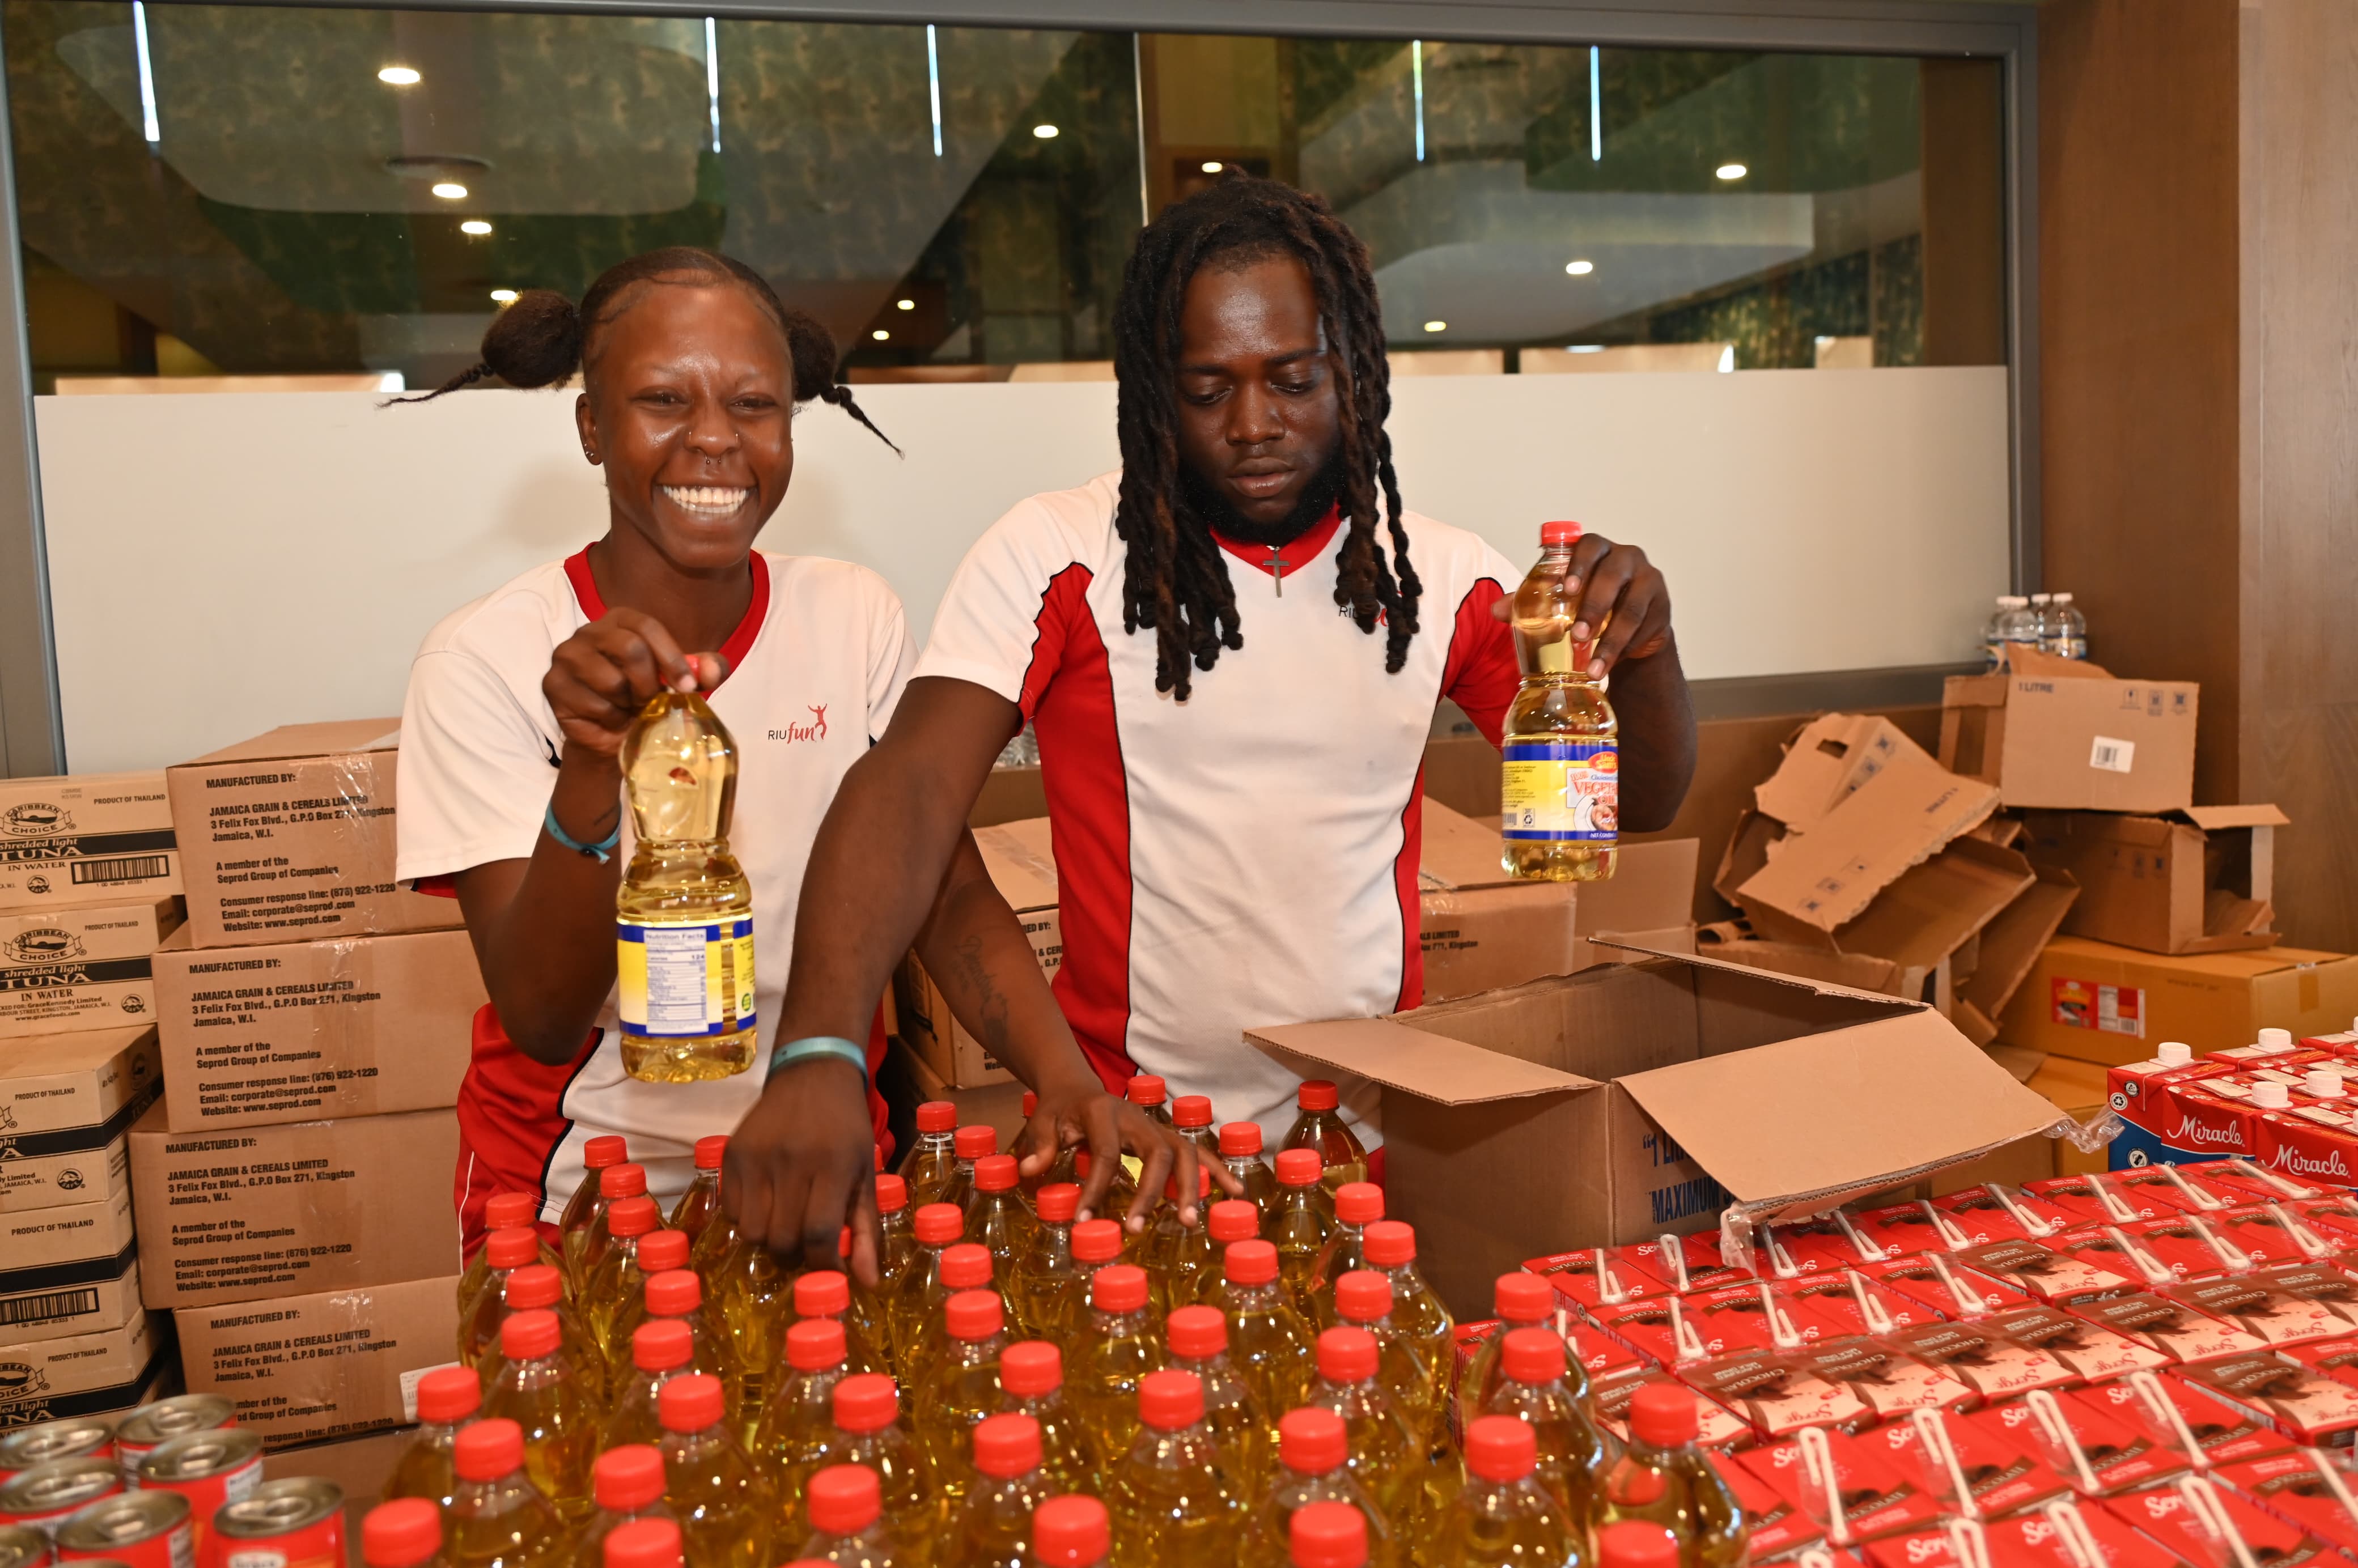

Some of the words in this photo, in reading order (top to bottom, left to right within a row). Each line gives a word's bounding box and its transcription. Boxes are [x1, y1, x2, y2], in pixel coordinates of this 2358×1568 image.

[2024, 682, 2054, 693] LITRE
[768, 730, 787, 740] RIU
[787, 721, 815, 744] fun
[206, 774, 279, 788] MANUFACTURED
[281, 773, 295, 783] BY:
[7, 804, 59, 817] CARIBBEAN
[210, 804, 251, 817] JAMAICA
[252, 802, 280, 813] GRAIN
[282, 801, 289, 811] &
[291, 798, 330, 810] CEREALS
[12, 824, 57, 834] CHOICE
[211, 820, 217, 830] 3
[219, 818, 241, 828] Felix
[243, 817, 260, 827] Fox
[261, 815, 288, 825] Blvd.,
[290, 811, 315, 823] G.P.O
[316, 811, 333, 821] Box
[0, 839, 49, 850] shredded
[52, 838, 78, 848] light
[213, 831, 253, 842] Jamaica,
[255, 828, 274, 838] W.I.
[0, 847, 84, 861] TUNA
[25, 861, 66, 870] WATER
[217, 861, 223, 871] A
[224, 859, 260, 870] member
[262, 857, 272, 867] of
[274, 856, 289, 866] the
[217, 872, 249, 885] Seprod
[250, 871, 277, 881] Group
[279, 869, 288, 878] of
[290, 865, 339, 878] Companies
[220, 896, 265, 907] Consumer
[266, 892, 307, 904] response
[308, 890, 329, 899] line:
[354, 882, 396, 895] 922-1220
[222, 908, 250, 920] Email:
[252, 900, 355, 917] corporate@seprod.com
[223, 920, 263, 932] Website:
[264, 914, 341, 928] www.seprod.com
[20, 950, 67, 961] CHOICE
[5, 965, 56, 978] shredded
[59, 964, 86, 974] light
[189, 959, 264, 974] MANUFACTURED
[266, 958, 281, 968] BY:
[1, 973, 93, 989] TUNA
[21, 993, 32, 1002] IN
[37, 988, 74, 1000] WATER
[192, 990, 234, 1002] JAMAICA
[235, 987, 264, 998] GRAIN
[266, 987, 273, 996] &
[275, 983, 316, 996] CEREALS
[192, 1005, 198, 1015] 3
[201, 1004, 224, 1014] Felix
[226, 1002, 242, 1012] Fox
[244, 1000, 272, 1010] Blvd.,
[274, 997, 298, 1008] G.P.O
[300, 997, 317, 1006] Box
[342, 992, 381, 1003] Kingston
[193, 1016, 236, 1027] Jamaica,
[238, 1014, 256, 1023] W.I.
[196, 1047, 203, 1056] A
[205, 1044, 241, 1056] member
[244, 1042, 253, 1052] of
[255, 1042, 271, 1051] the
[197, 1057, 229, 1069] Seprod
[231, 1056, 258, 1066] Group
[260, 1053, 269, 1063] of
[272, 1050, 321, 1063] Companies
[199, 1081, 244, 1092] Consumer
[246, 1077, 287, 1088] response
[290, 1074, 310, 1083] line:
[312, 1071, 335, 1083] (876)
[336, 1067, 378, 1080] 922-1220
[200, 1093, 229, 1104] Email:
[231, 1085, 337, 1102] corporate@seprod.com
[201, 1105, 241, 1116] Website:
[243, 1098, 321, 1112] www.seprod.com
[2166, 1114, 2243, 1145] Miracle
[166, 1138, 239, 1153] MANUFACTURED
[241, 1137, 256, 1147] BY:
[2261, 1144, 2349, 1176] Miracle
[7, 1172, 36, 1182] Limited
[168, 1168, 209, 1181] JAMAICA
[211, 1166, 239, 1178] GRAIN
[241, 1166, 249, 1175] &
[251, 1162, 290, 1174] CEREALS
[292, 1159, 328, 1170] LIMITED
[168, 1184, 175, 1193] 3
[177, 1182, 200, 1192] Felix
[201, 1181, 218, 1191] Fox
[220, 1179, 247, 1189] Blvd.,
[249, 1175, 273, 1187] G.P.O
[275, 1175, 292, 1184] Box
[294, 1172, 314, 1183] 271,
[316, 1170, 355, 1181] Kingston
[169, 1194, 211, 1205] Jamaica,
[213, 1192, 232, 1202] W.I.
[1652, 1176, 1719, 1224] MAXIMUM
[11, 1225, 45, 1235] PRODUCT
[57, 1219, 94, 1229] THAILAND
[172, 1224, 179, 1234] A
[180, 1222, 217, 1233] member
[219, 1220, 228, 1230] of
[230, 1219, 245, 1229] the
[172, 1234, 204, 1246] Seprod
[206, 1234, 232, 1243] Group
[235, 1231, 244, 1240] of
[246, 1227, 295, 1239] Companies
[175, 1257, 219, 1268] Consumer
[221, 1253, 262, 1264] response
[264, 1251, 284, 1260] line:
[286, 1247, 309, 1259] (876)
[310, 1243, 352, 1256] 922-1220
[176, 1269, 204, 1280] Email:
[206, 1260, 310, 1278] corporate@seprod.com
[176, 1281, 217, 1291] Website:
[218, 1273, 295, 1287] www.seprod.com
[210, 1312, 282, 1328] MANUFACTURED
[286, 1310, 300, 1320] BY:
[213, 1344, 252, 1357] JAMAICA
[255, 1340, 282, 1353] GRAIN
[285, 1339, 291, 1349] &
[294, 1333, 333, 1348] CEREALS
[335, 1329, 370, 1342] LIMITED
